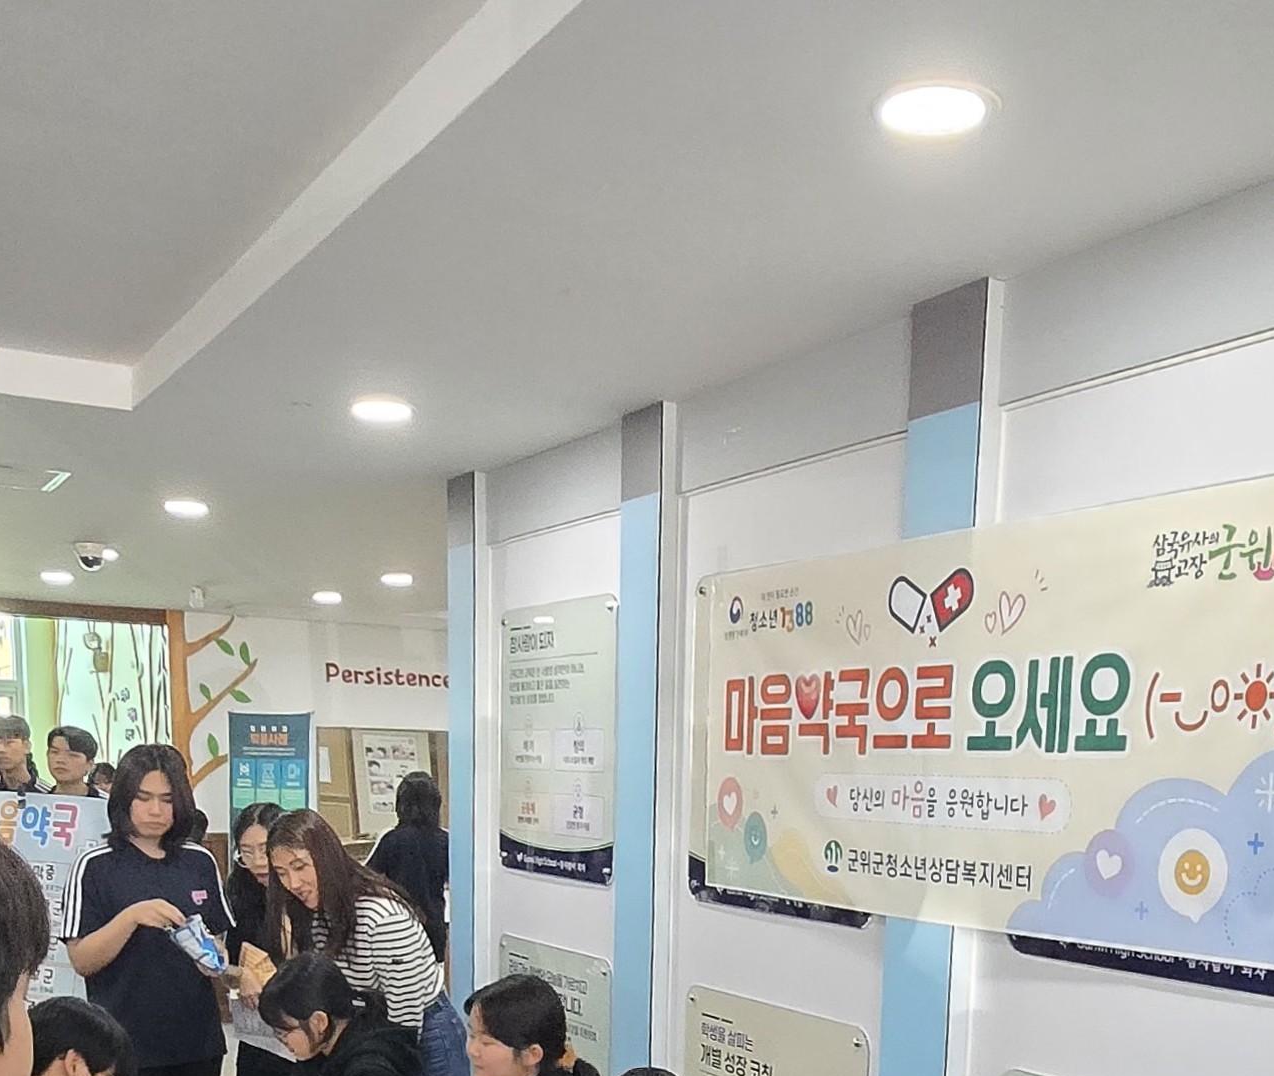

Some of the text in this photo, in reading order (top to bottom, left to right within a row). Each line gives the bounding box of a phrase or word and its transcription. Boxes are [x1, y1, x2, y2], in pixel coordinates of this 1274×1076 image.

[1153, 530, 1220, 559] 삼국유사의
[1208, 523, 1273, 580] 군위
[1175, 553, 1207, 580] 고장
[725, 653, 1131, 755] 마음약국으로 오세요
[849, 780, 1028, 820] 당신의 마음을 응원합니다
[848, 848, 1033, 892] 군위군청소년상담복지센터
[700, 1044, 722, 1070] 개별
[724, 1051, 747, 1076] 성장
